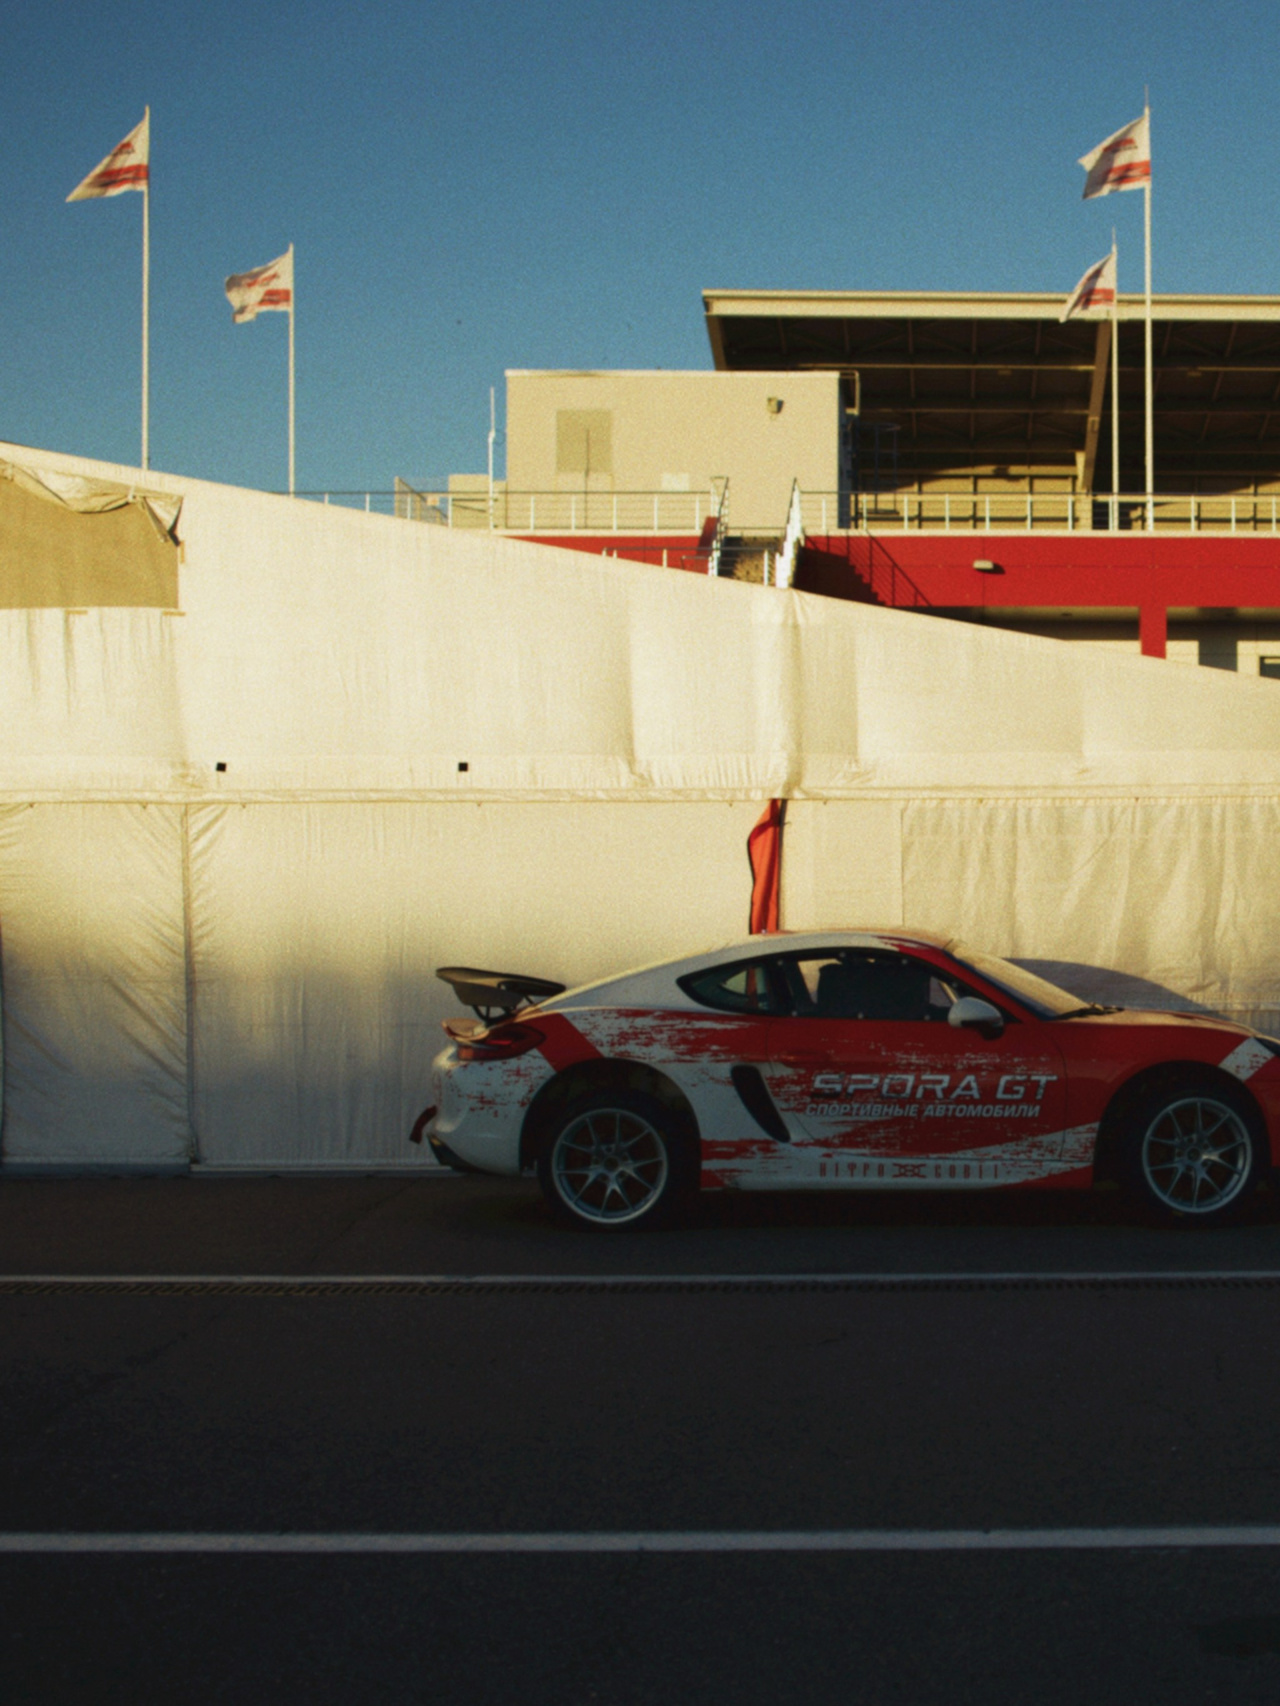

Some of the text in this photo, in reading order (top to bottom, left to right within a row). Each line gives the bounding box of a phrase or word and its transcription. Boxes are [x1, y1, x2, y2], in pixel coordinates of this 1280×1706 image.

[810, 1074, 1058, 1100] SPORA GT
[804, 1103, 1041, 1118] СПОРТИВНЫЕ АВТОМОБИЛИ
